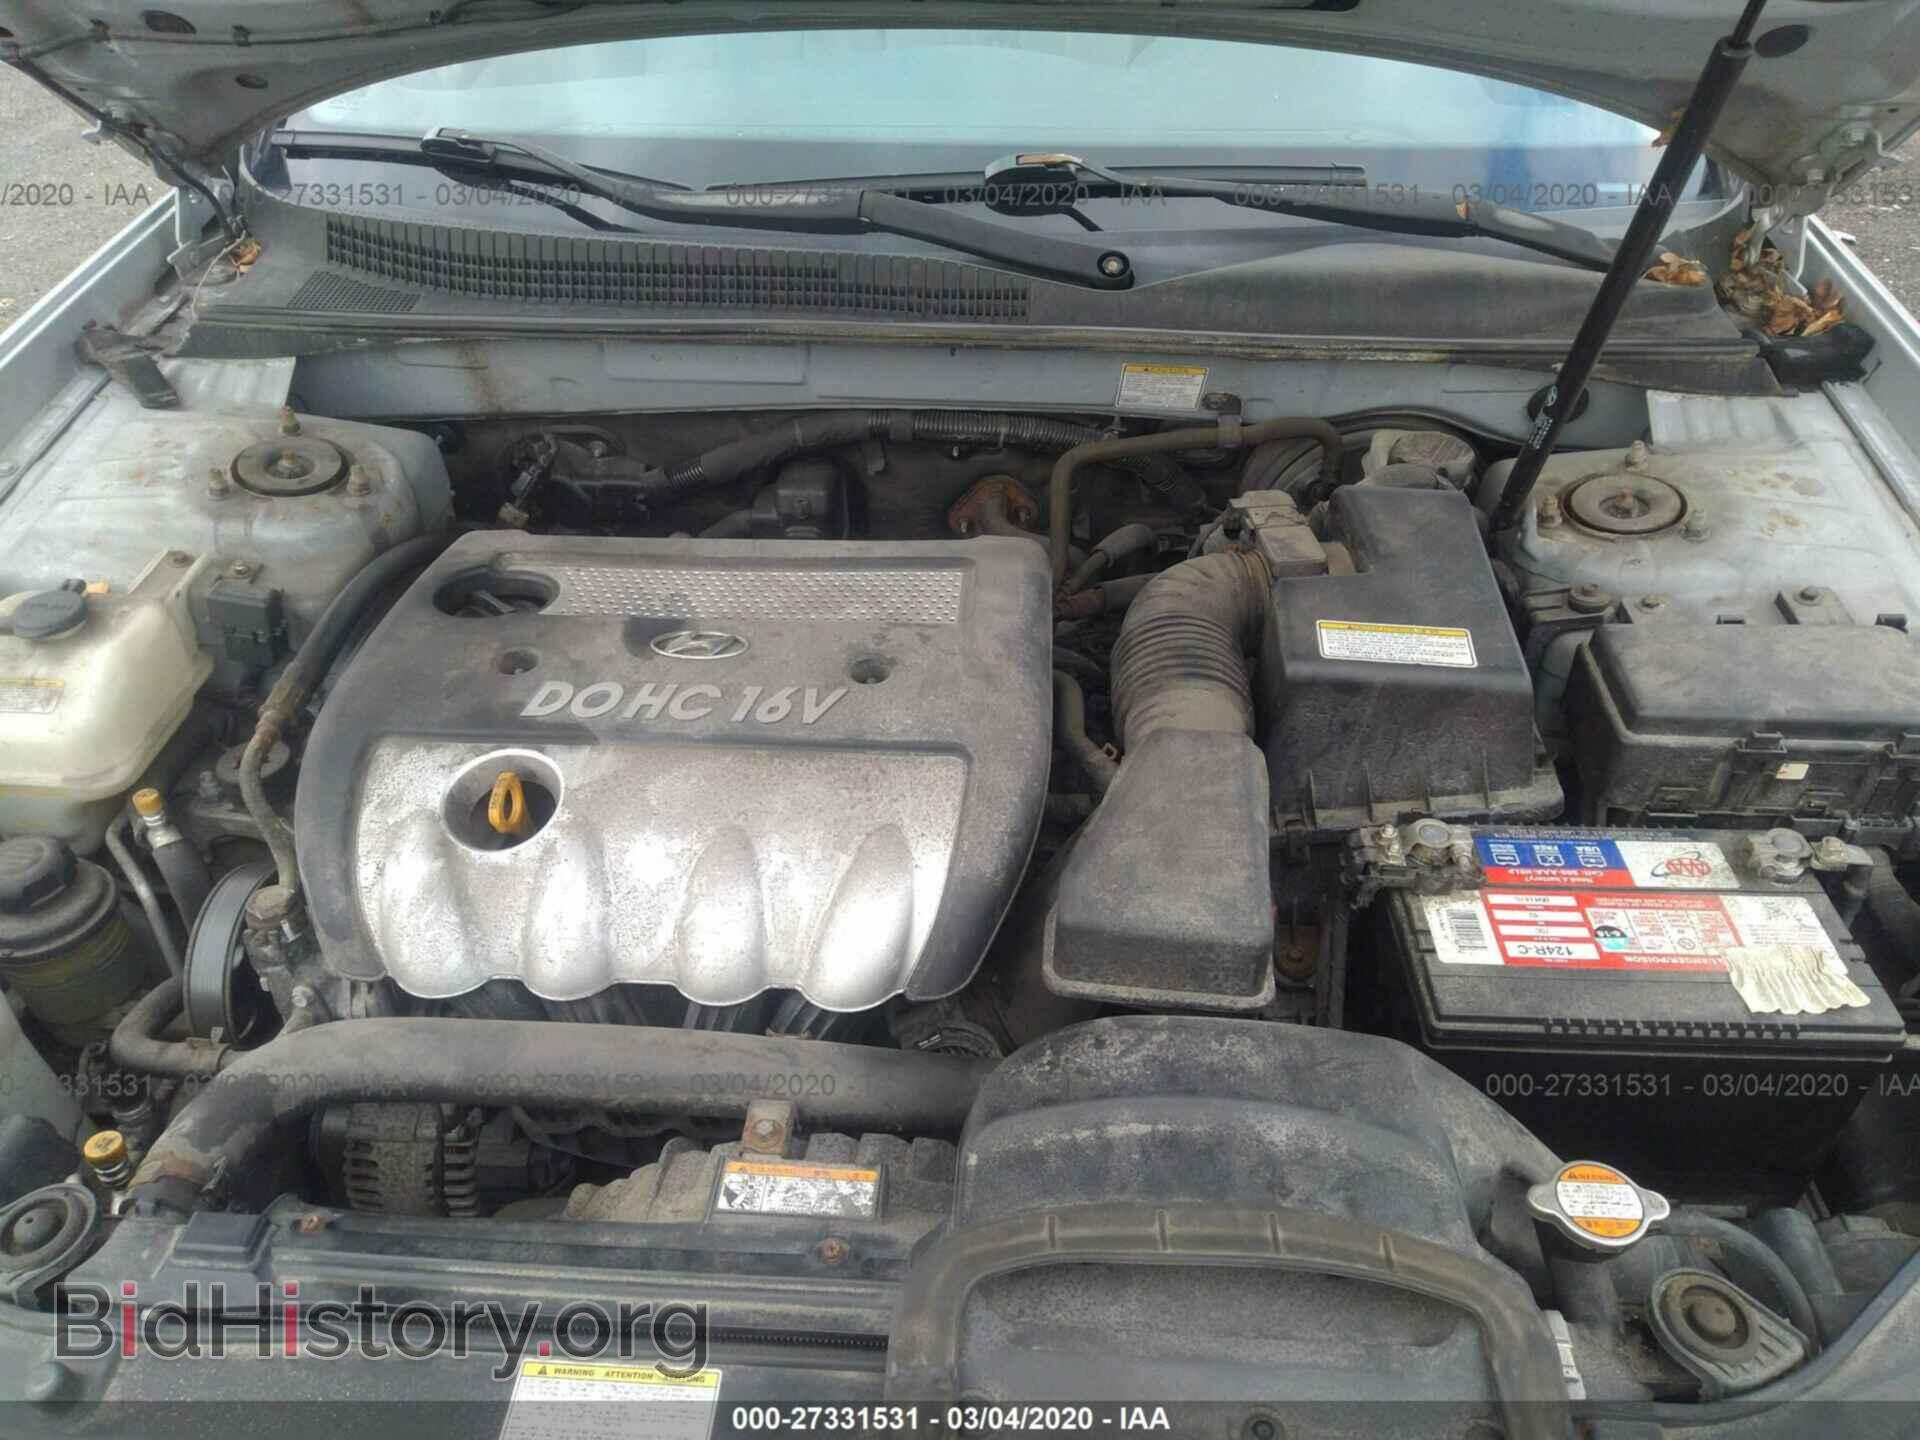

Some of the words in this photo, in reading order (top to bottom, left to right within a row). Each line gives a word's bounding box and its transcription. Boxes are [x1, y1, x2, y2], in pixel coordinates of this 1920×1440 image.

[520, 681, 722, 719] DOHC
[731, 686, 849, 725] 16V
[1516, 944, 1574, 956] 124R-C
[552, 1367, 596, 1378] WARNING
[603, 1369, 655, 1381] ATTENTION
